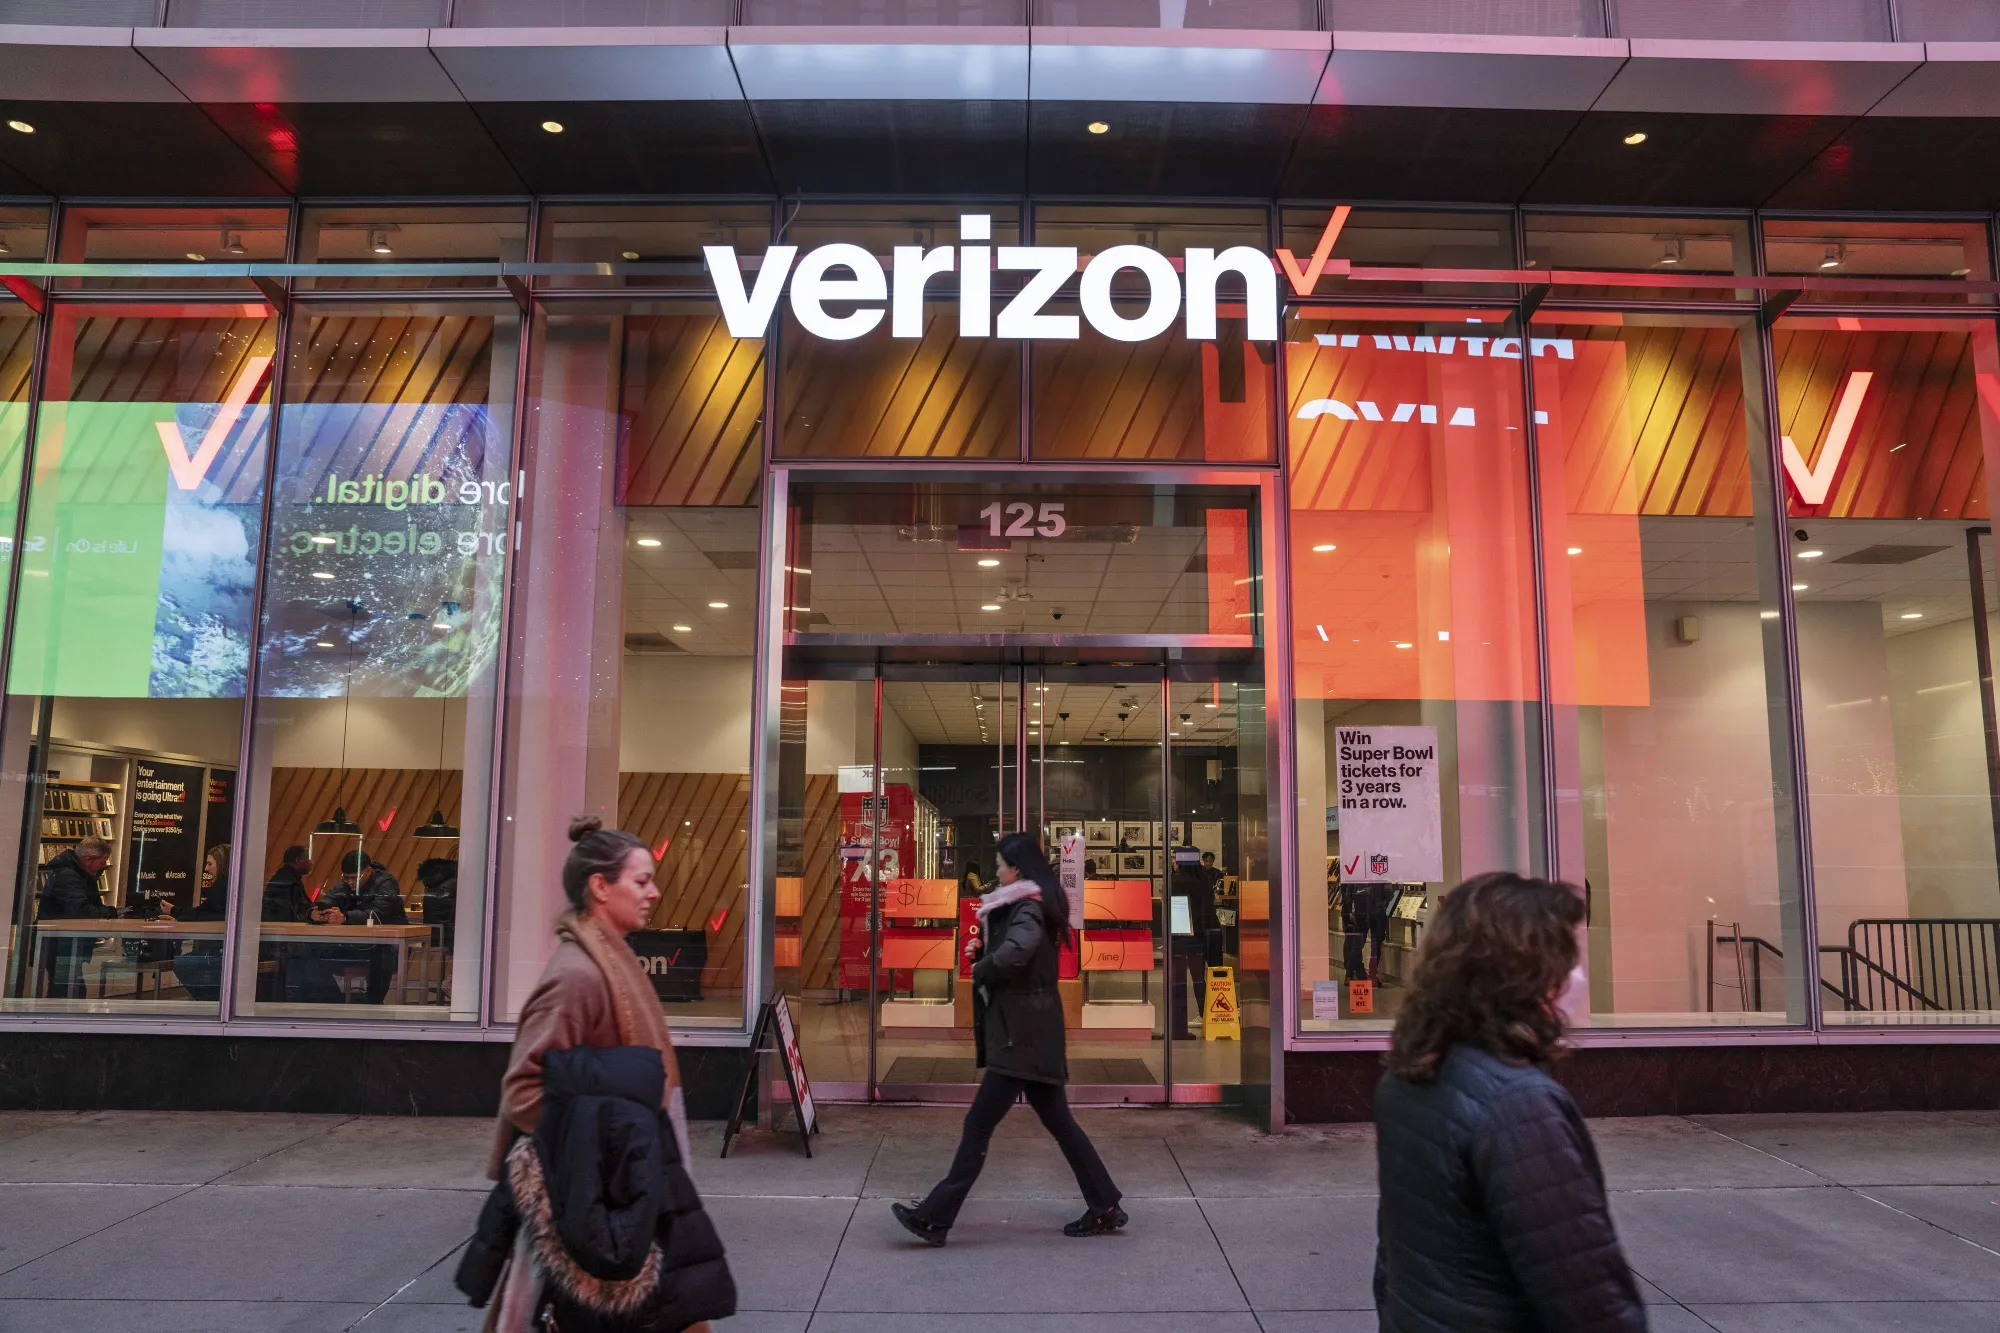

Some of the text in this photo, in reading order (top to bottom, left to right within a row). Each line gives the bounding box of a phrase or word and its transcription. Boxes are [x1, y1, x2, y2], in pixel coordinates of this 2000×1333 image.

[703, 213, 1278, 341] verizon
[980, 501, 1066, 537] 125
[1340, 731, 1371, 745] Win
[1340, 746, 1433, 763] Super Bowl
[138, 765, 154, 777] Your
[1341, 763, 1423, 778] tickets for
[136, 779, 184, 791] entertainment
[1342, 779, 1401, 796] 3 years
[136, 790, 142, 800] is
[142, 791, 161, 803] going
[1342, 795, 1407, 809] in a row.
[134, 811, 154, 820] Everyone
[173, 814, 183, 822] they
[133, 825, 148, 834] Saving
[1372, 862, 1387, 873] NFL
[141, 871, 157, 880] Music
[169, 871, 187, 879] Arcade
[1097, 951, 1120, 962] /line
